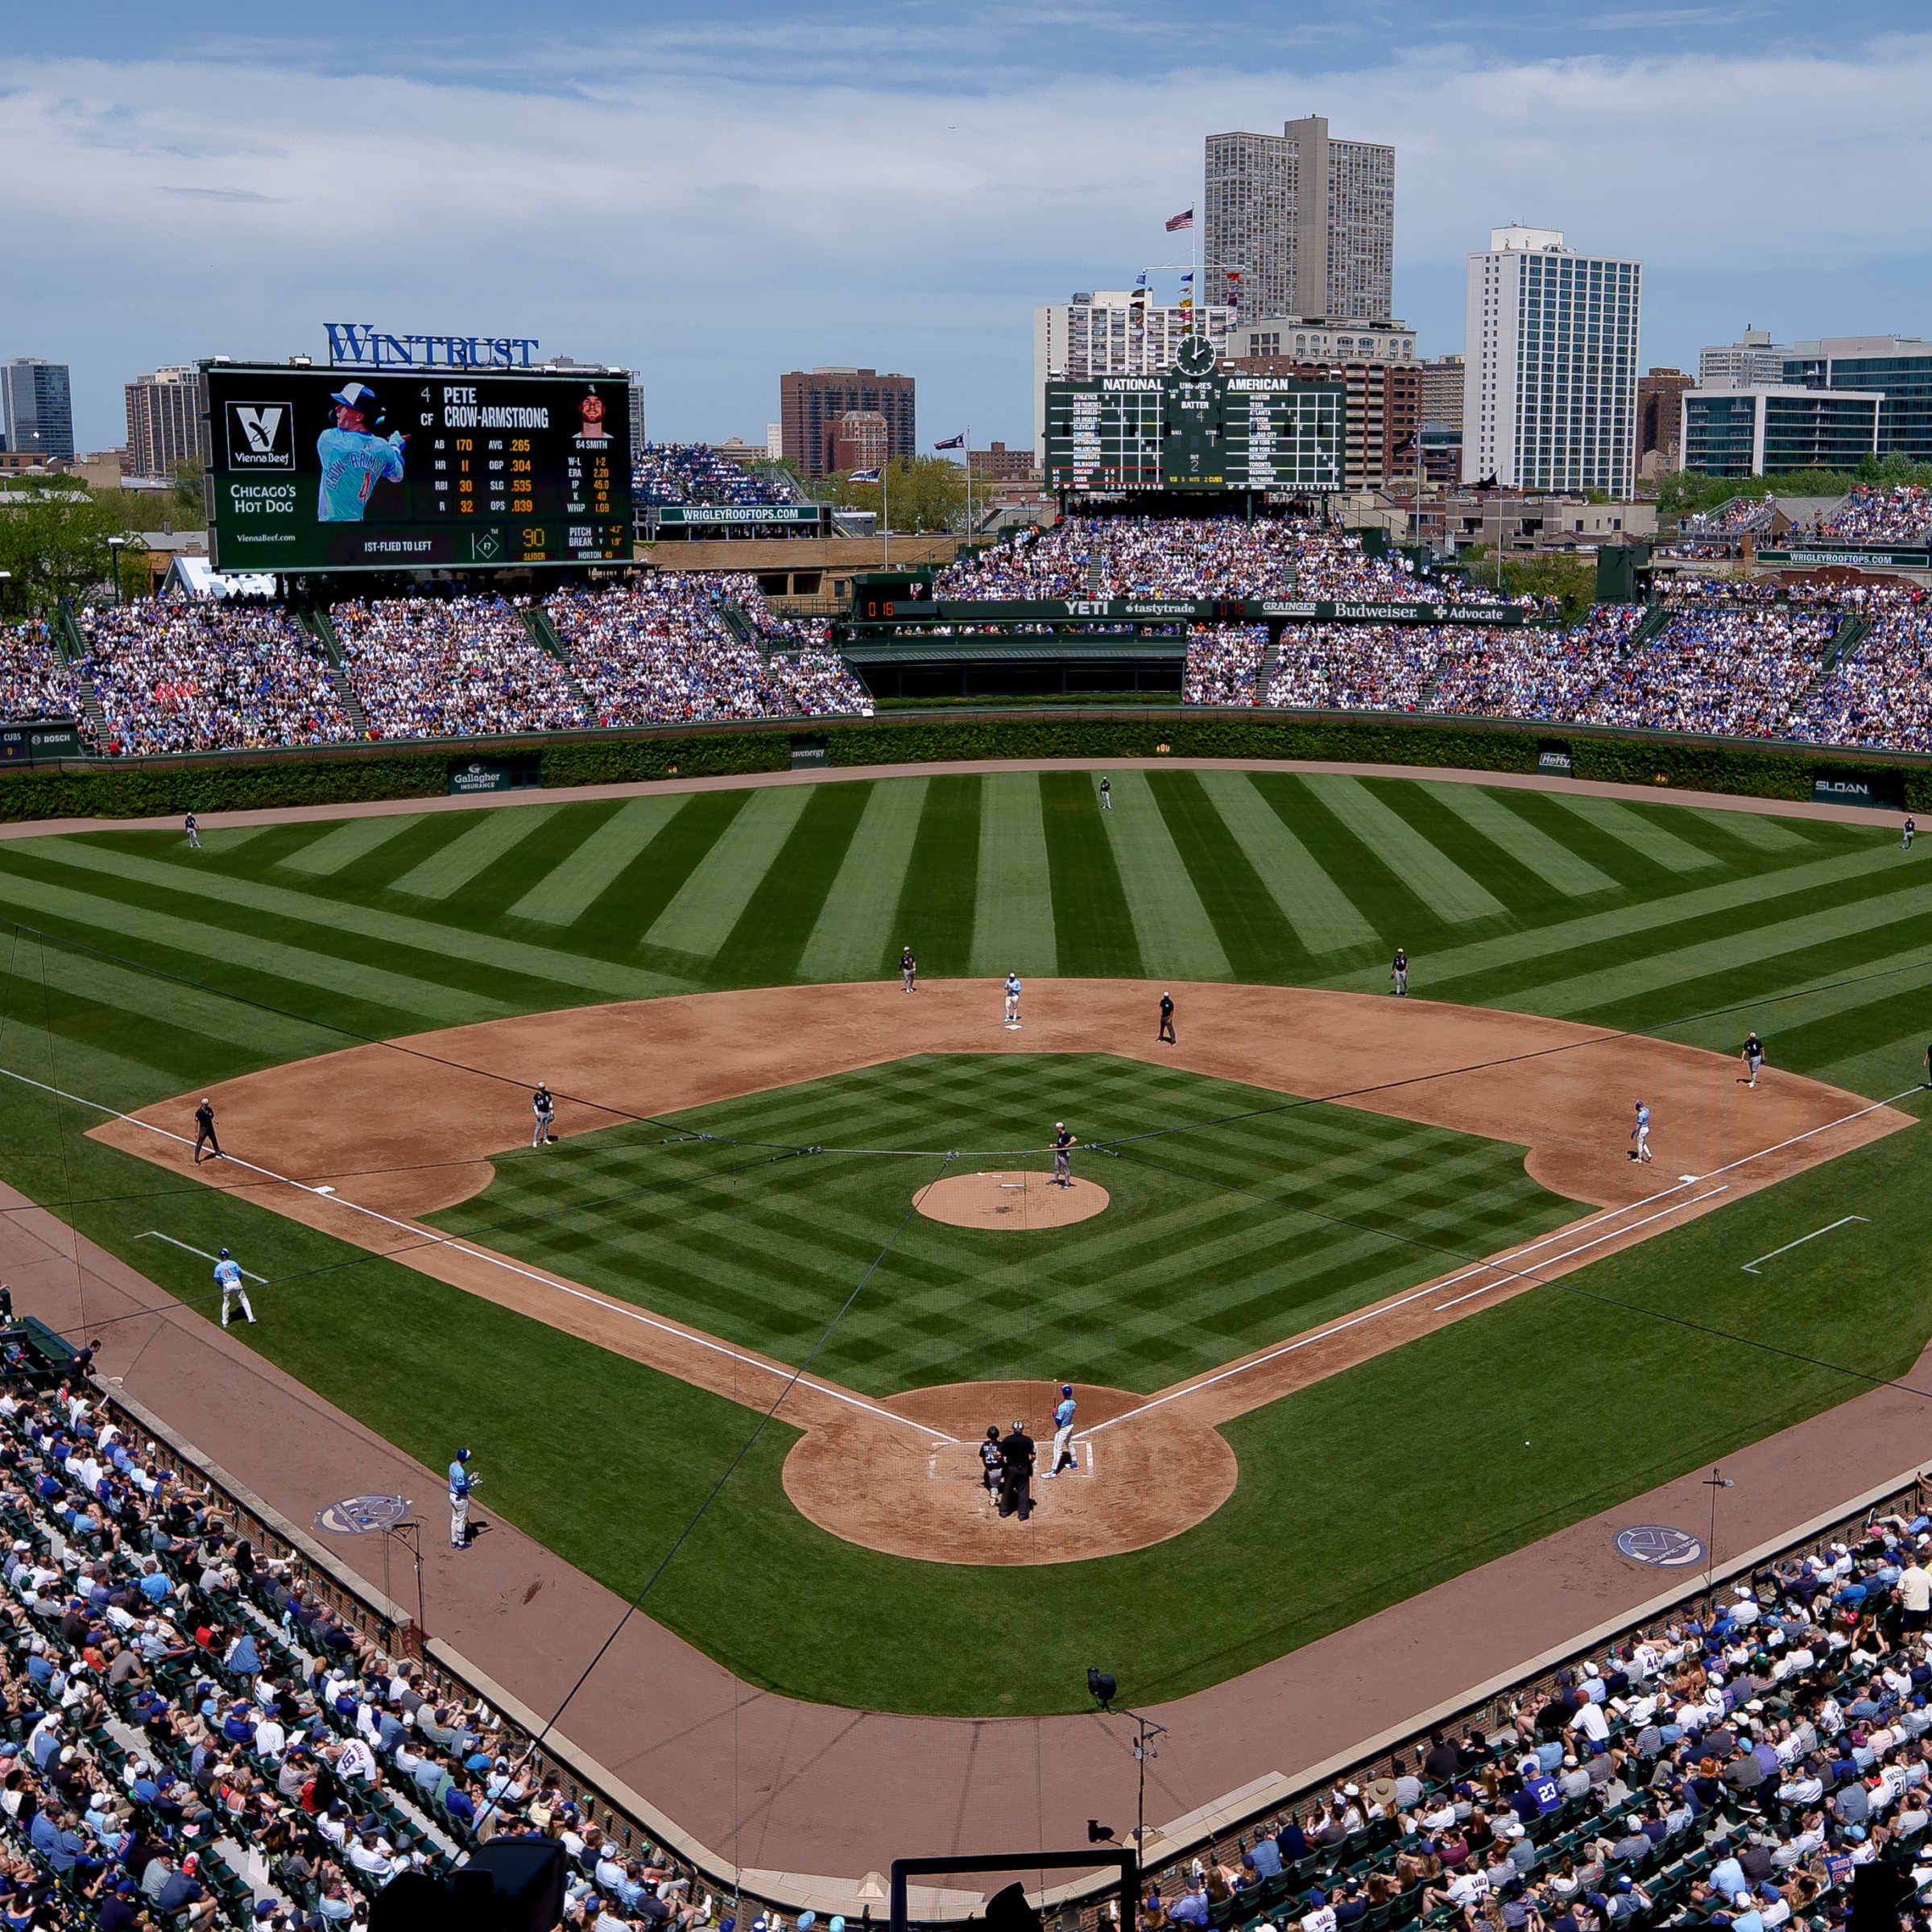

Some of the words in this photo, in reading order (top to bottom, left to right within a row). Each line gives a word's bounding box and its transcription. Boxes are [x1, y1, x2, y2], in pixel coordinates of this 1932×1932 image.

[323, 322, 540, 369] WINTRUST
[1103, 379, 1165, 391] NATIONAL
[1227, 379, 1289, 391] AMERICAN
[420, 387, 431, 403] 4
[443, 387, 477, 404] PETE
[1181, 401, 1210, 409] BATTER
[420, 413, 433, 426] CF
[445, 406, 549, 428] CROW-ARMSTRONG
[1196, 411, 1204, 423] 4
[435, 440, 445, 449] AB
[456, 439, 473, 451] 170
[488, 440, 503, 449] AVG
[510, 439, 530, 451] .265
[576, 440, 585, 449] 64
[586, 440, 608, 449] SMITH
[235, 453, 267, 463] Vienna
[268, 453, 289, 465] Beef
[568, 457, 581, 466] W-L
[596, 457, 606, 466] 1-2
[435, 460, 446, 470] HR
[461, 459, 469, 472] 11
[489, 461, 504, 470] OBP
[510, 459, 532, 472] .304
[1191, 461, 1198, 472] 2
[569, 469, 582, 478] ERA
[593, 468, 609, 478] 2.20
[230, 484, 296, 498] CHICAGO'S
[358, 471, 372, 500] 4
[435, 481, 448, 490] RBI
[459, 480, 473, 493] 30
[490, 481, 504, 490] SLG
[511, 480, 532, 493] .535
[572, 481, 579, 490] IP
[594, 480, 609, 490] 45.0
[573, 492, 578, 501] K
[597, 491, 606, 501] 40
[235, 499, 262, 513] HOT
[266, 499, 294, 513] DOG
[440, 502, 445, 511] R
[461, 500, 474, 513] 32
[490, 501, 506, 511] OPS
[567, 503, 585, 512] WHIP
[595, 503, 610, 512] 1.09
[683, 509, 798, 520] WRIGLEYROOFTOPS.COM
[237, 534, 296, 542] ViennaBeef.com
[523, 528, 544, 547] 90
[569, 527, 591, 537] PITCH
[403, 541, 412, 551] TO
[414, 541, 432, 551] LEFT
[484, 543, 491, 551] F7
[569, 537, 593, 547] BREAK
[523, 552, 546, 561] SLIDER
[578, 551, 602, 559] HORTON
[1790, 552, 1892, 564] WRIGLEYROOFTOPS.COM
[1065, 601, 1110, 615] YETI
[1134, 603, 1195, 615] tastytrade
[1263, 602, 1317, 610] GRAINGER
[1334, 602, 1416, 618] Budweiser
[1450, 607, 1503, 620] Advocate
[3, 733, 21, 741] CUBS
[44, 734, 70, 743] BOSCH
[1541, 755, 1570, 767] Hefty
[454, 773, 500, 783] Gallagher
[461, 782, 494, 790] INSURANCE
[1815, 780, 1868, 795] SLOAN
[1647, 1548, 1678, 1564] TRAFFIC
[1678, 1538, 1698, 1549] TECH
[1647, 1656, 1657, 1669] 44
[342, 1748, 356, 1769] 18
[1538, 1782, 1556, 1802] 23
[1894, 1779, 1905, 1795] 21
